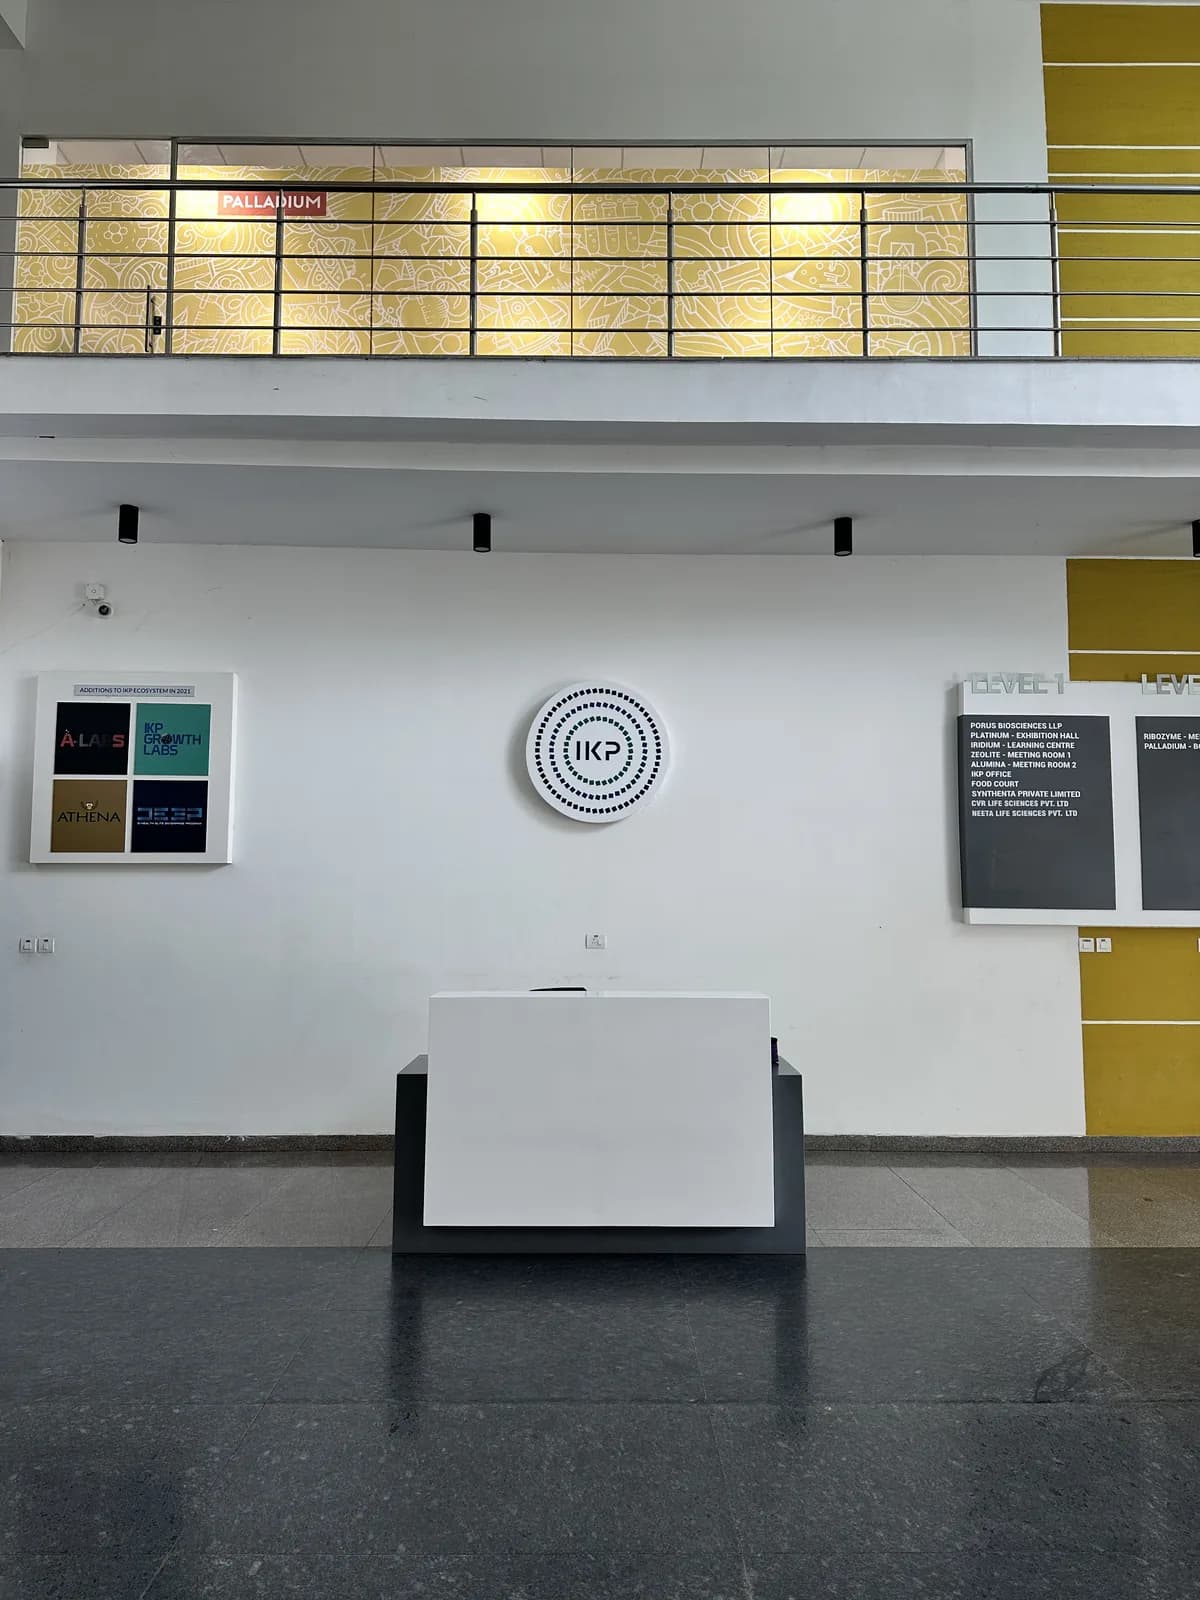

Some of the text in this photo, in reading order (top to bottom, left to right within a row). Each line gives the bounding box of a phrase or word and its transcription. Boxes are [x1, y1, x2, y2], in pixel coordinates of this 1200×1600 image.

[223, 195, 321, 209] PALLADIUM
[969, 673, 1065, 695] LEVEL 1
[144, 723, 164, 734] IKP
[144, 745, 179, 756] LABS
[576, 741, 621, 761] IKP
[57, 811, 121, 823] ATHENA
